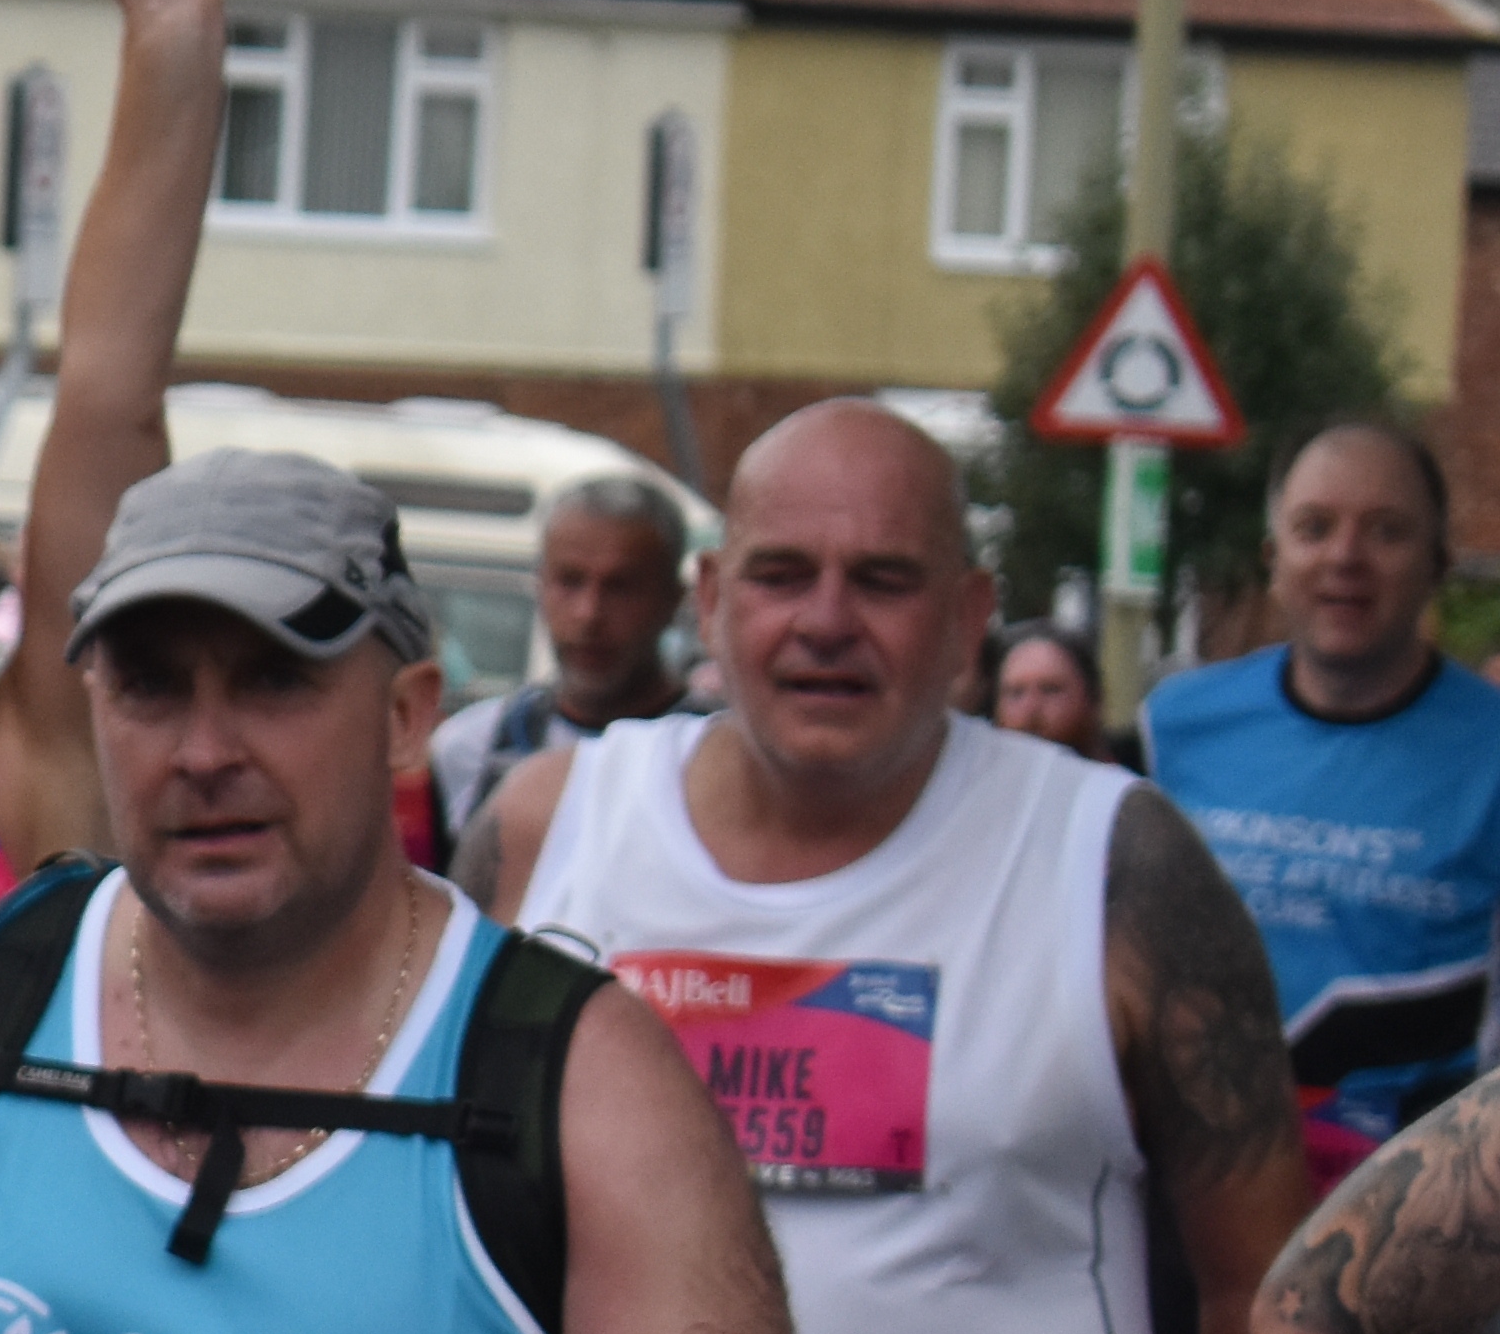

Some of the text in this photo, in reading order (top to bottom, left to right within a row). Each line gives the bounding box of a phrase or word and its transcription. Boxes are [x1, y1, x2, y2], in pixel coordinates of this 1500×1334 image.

[649, 968, 751, 1007] AJBell
[709, 1043, 816, 1099] MIKE
[721, 1103, 825, 1158] 559
